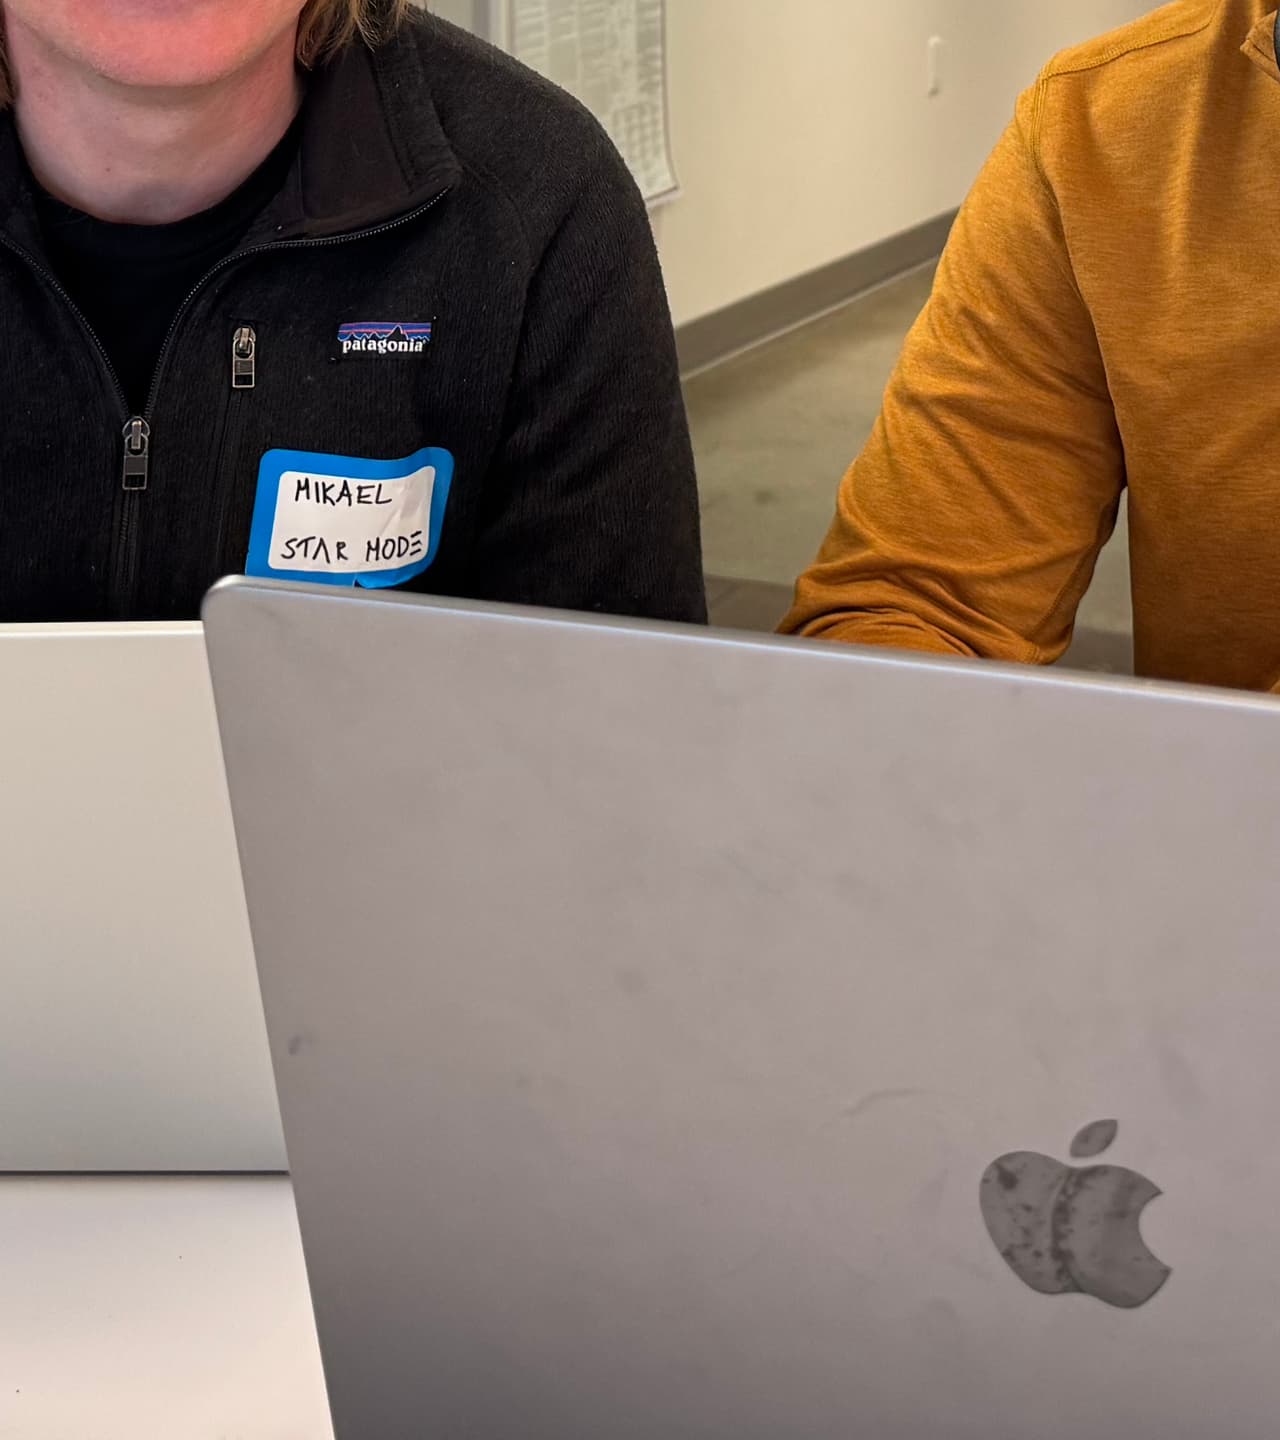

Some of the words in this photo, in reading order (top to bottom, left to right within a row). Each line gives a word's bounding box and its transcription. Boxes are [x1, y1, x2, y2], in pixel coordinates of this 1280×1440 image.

[342, 338, 423, 354] patagonia
[294, 477, 393, 507] MIKAEL
[280, 535, 349, 564] STAR
